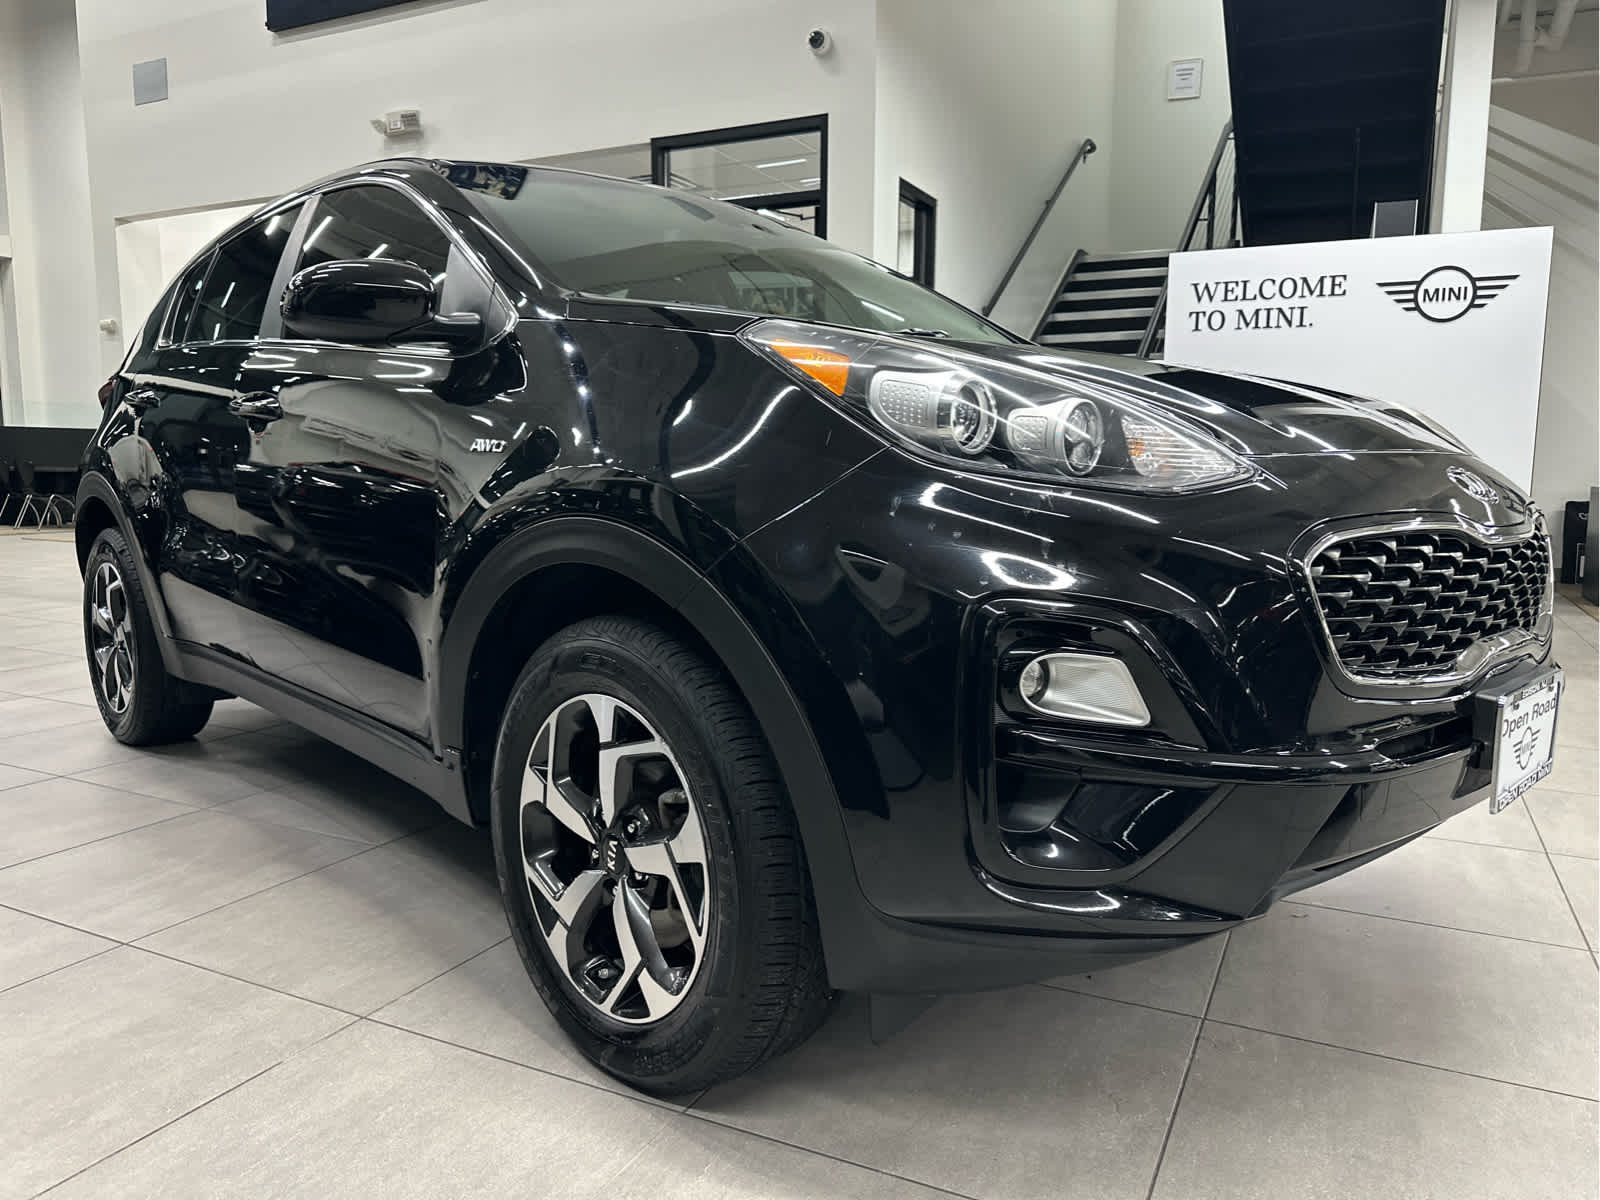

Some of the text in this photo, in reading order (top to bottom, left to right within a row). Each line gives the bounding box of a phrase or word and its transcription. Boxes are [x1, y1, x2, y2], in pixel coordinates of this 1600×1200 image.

[1191, 274, 1348, 304] WELCOME
[1421, 285, 1469, 303] MINI
[1188, 306, 1314, 333] TO MINI.
[469, 438, 507, 452] AWD
[1532, 698, 1556, 720] Road
[607, 840, 618, 871] KIA
